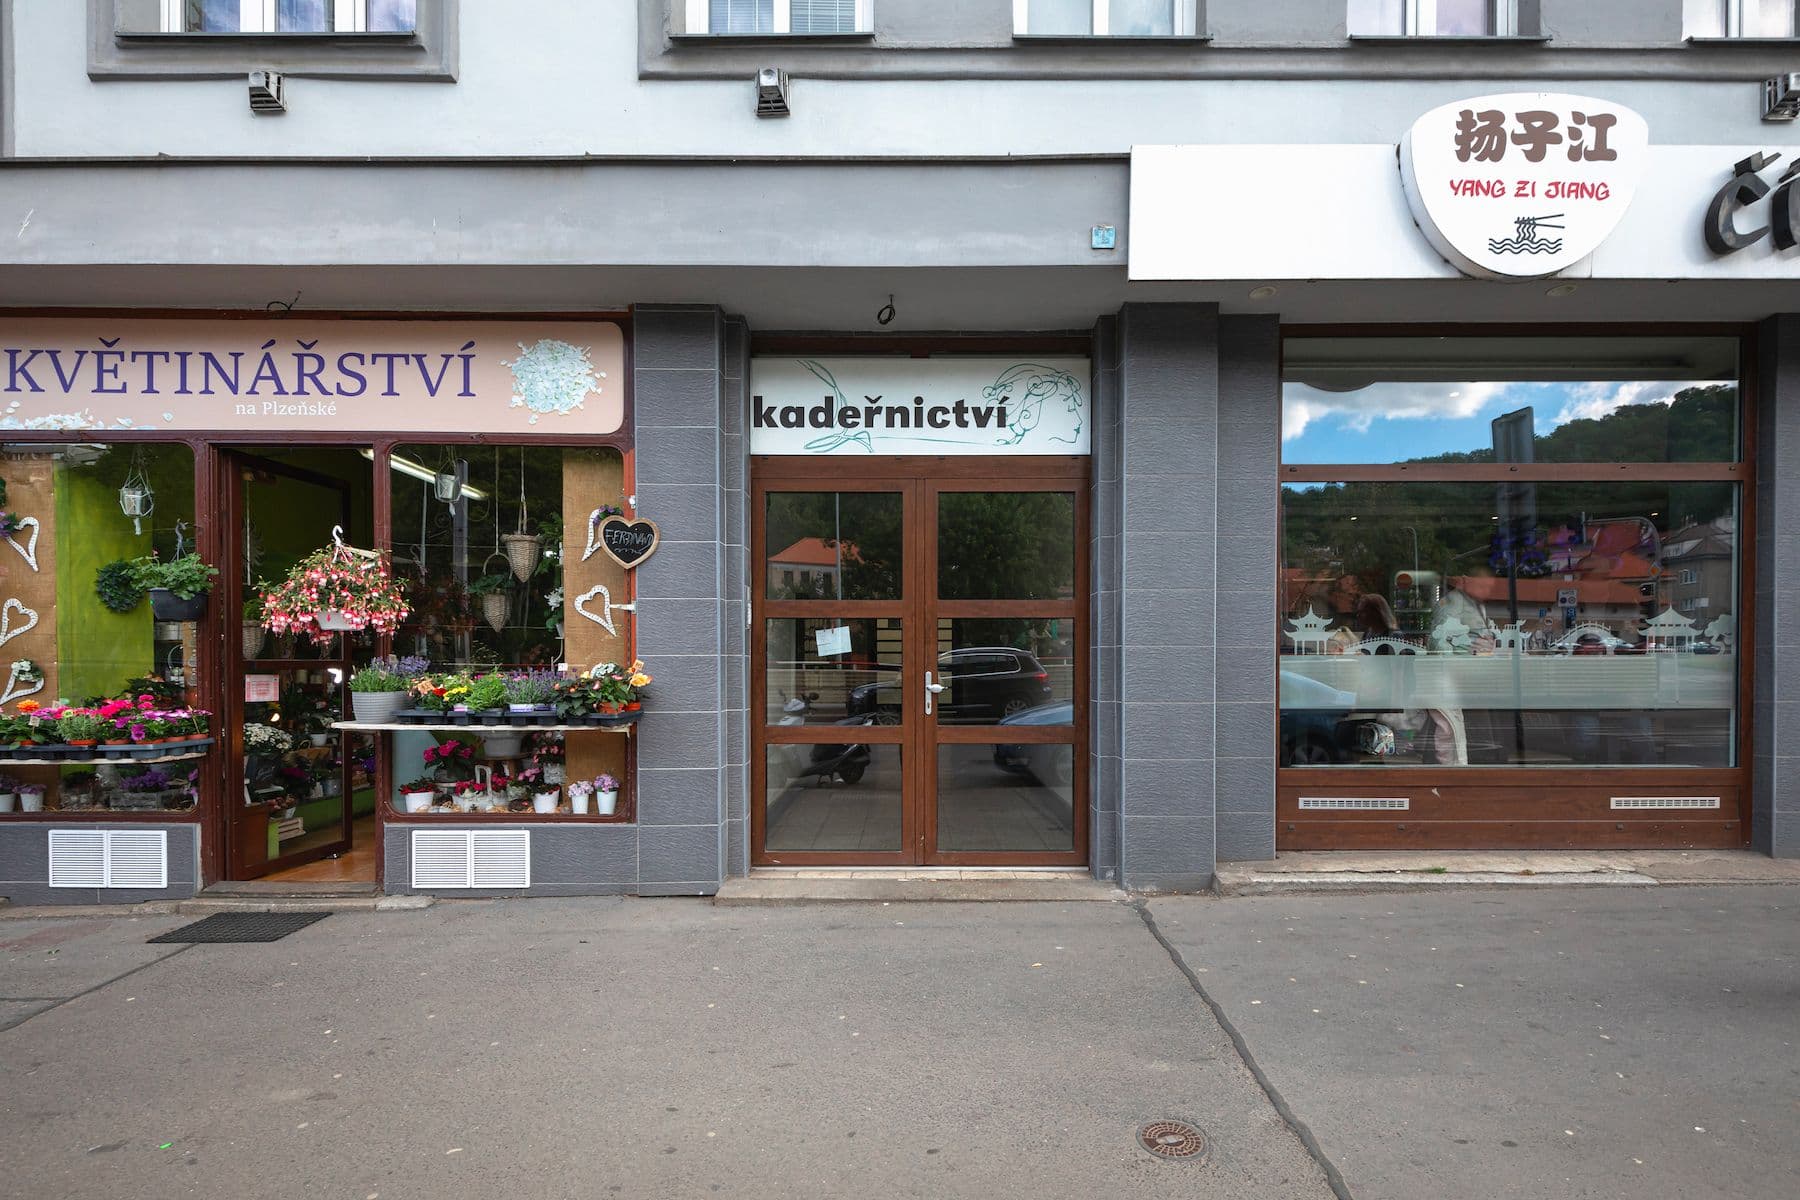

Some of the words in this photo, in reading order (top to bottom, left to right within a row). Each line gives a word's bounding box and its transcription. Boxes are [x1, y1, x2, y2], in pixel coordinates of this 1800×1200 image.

[1454, 109, 1618, 163] 扬子江
[1449, 179, 1506, 199] YANG
[1514, 180, 1536, 198] ZI
[1544, 181, 1611, 201] JIANG
[3, 337, 477, 398] KVĚTINÁŘSTVÍ
[235, 403, 256, 415] na
[262, 401, 337, 416] Plzeňské
[753, 395, 1010, 429] kadeřnictví
